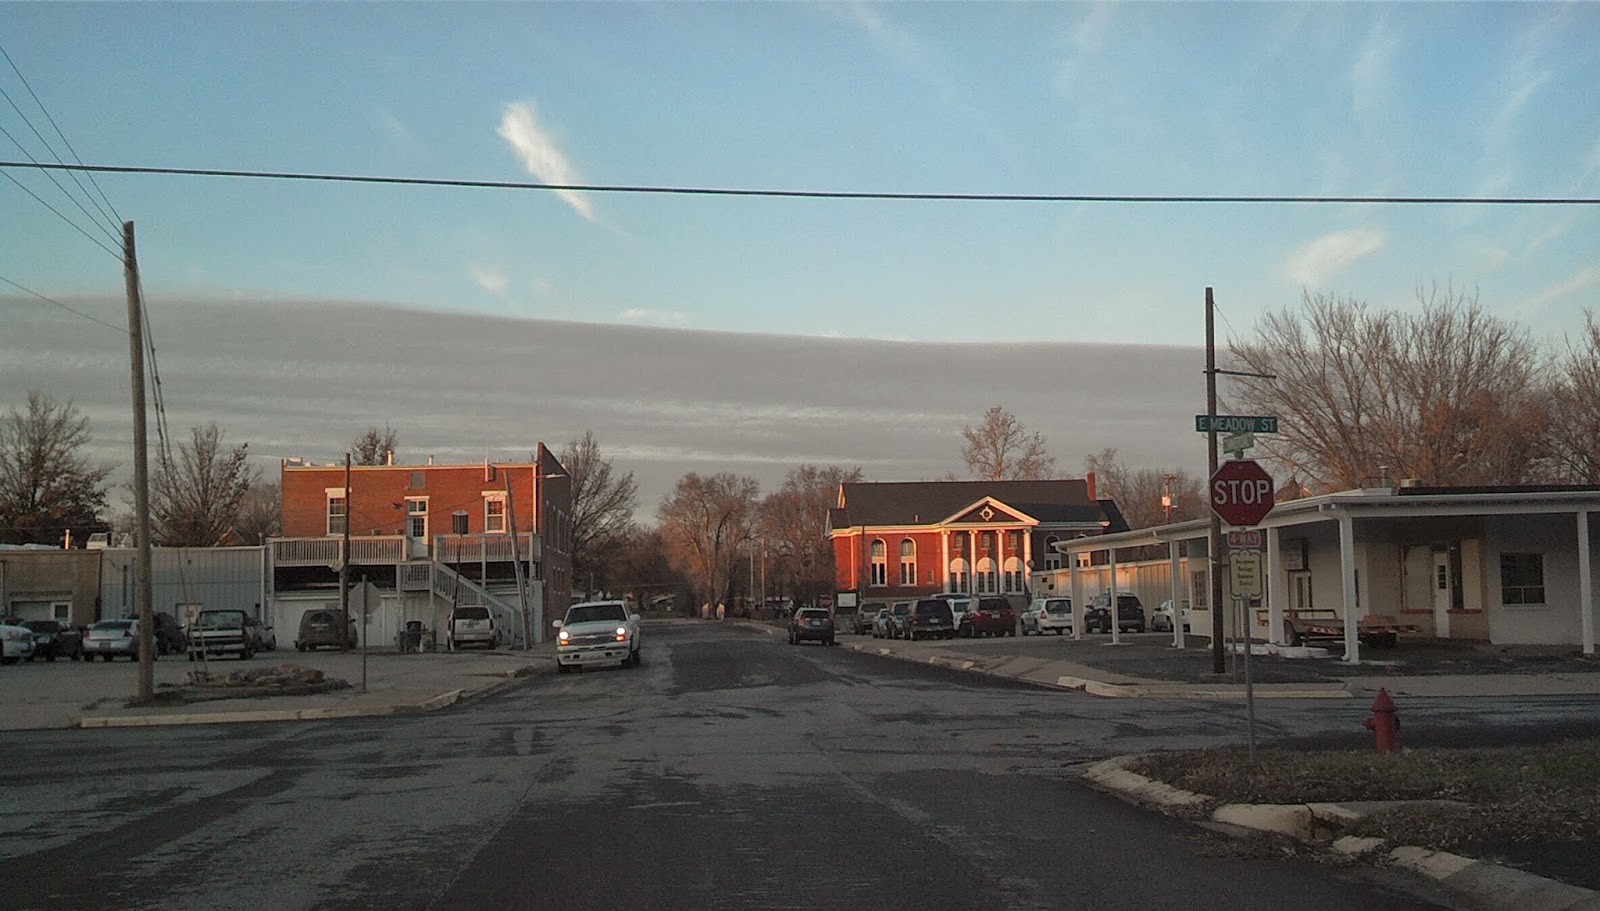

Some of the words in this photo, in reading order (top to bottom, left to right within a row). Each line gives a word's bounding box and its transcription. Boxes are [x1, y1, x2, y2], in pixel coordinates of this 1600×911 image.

[1199, 417, 1207, 430] E
[1210, 418, 1256, 431] MEADOW
[1261, 418, 1275, 431] ST
[1214, 480, 1270, 505] STOP
